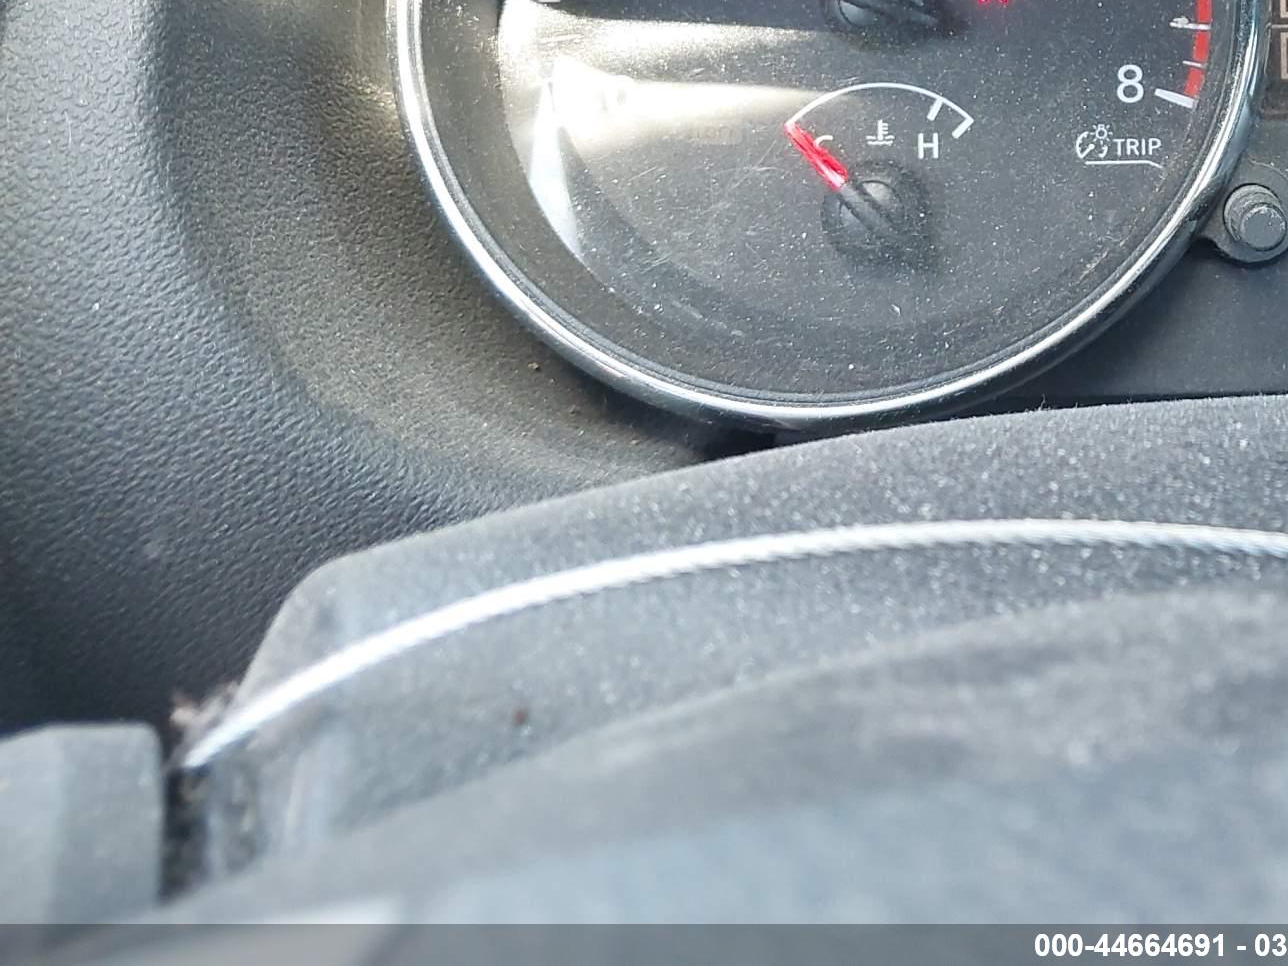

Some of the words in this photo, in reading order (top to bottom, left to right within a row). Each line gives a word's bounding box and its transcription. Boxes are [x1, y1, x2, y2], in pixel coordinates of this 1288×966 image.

[1116, 64, 1144, 103] 8
[918, 132, 938, 159] H
[1114, 138, 1161, 156] TRIP
